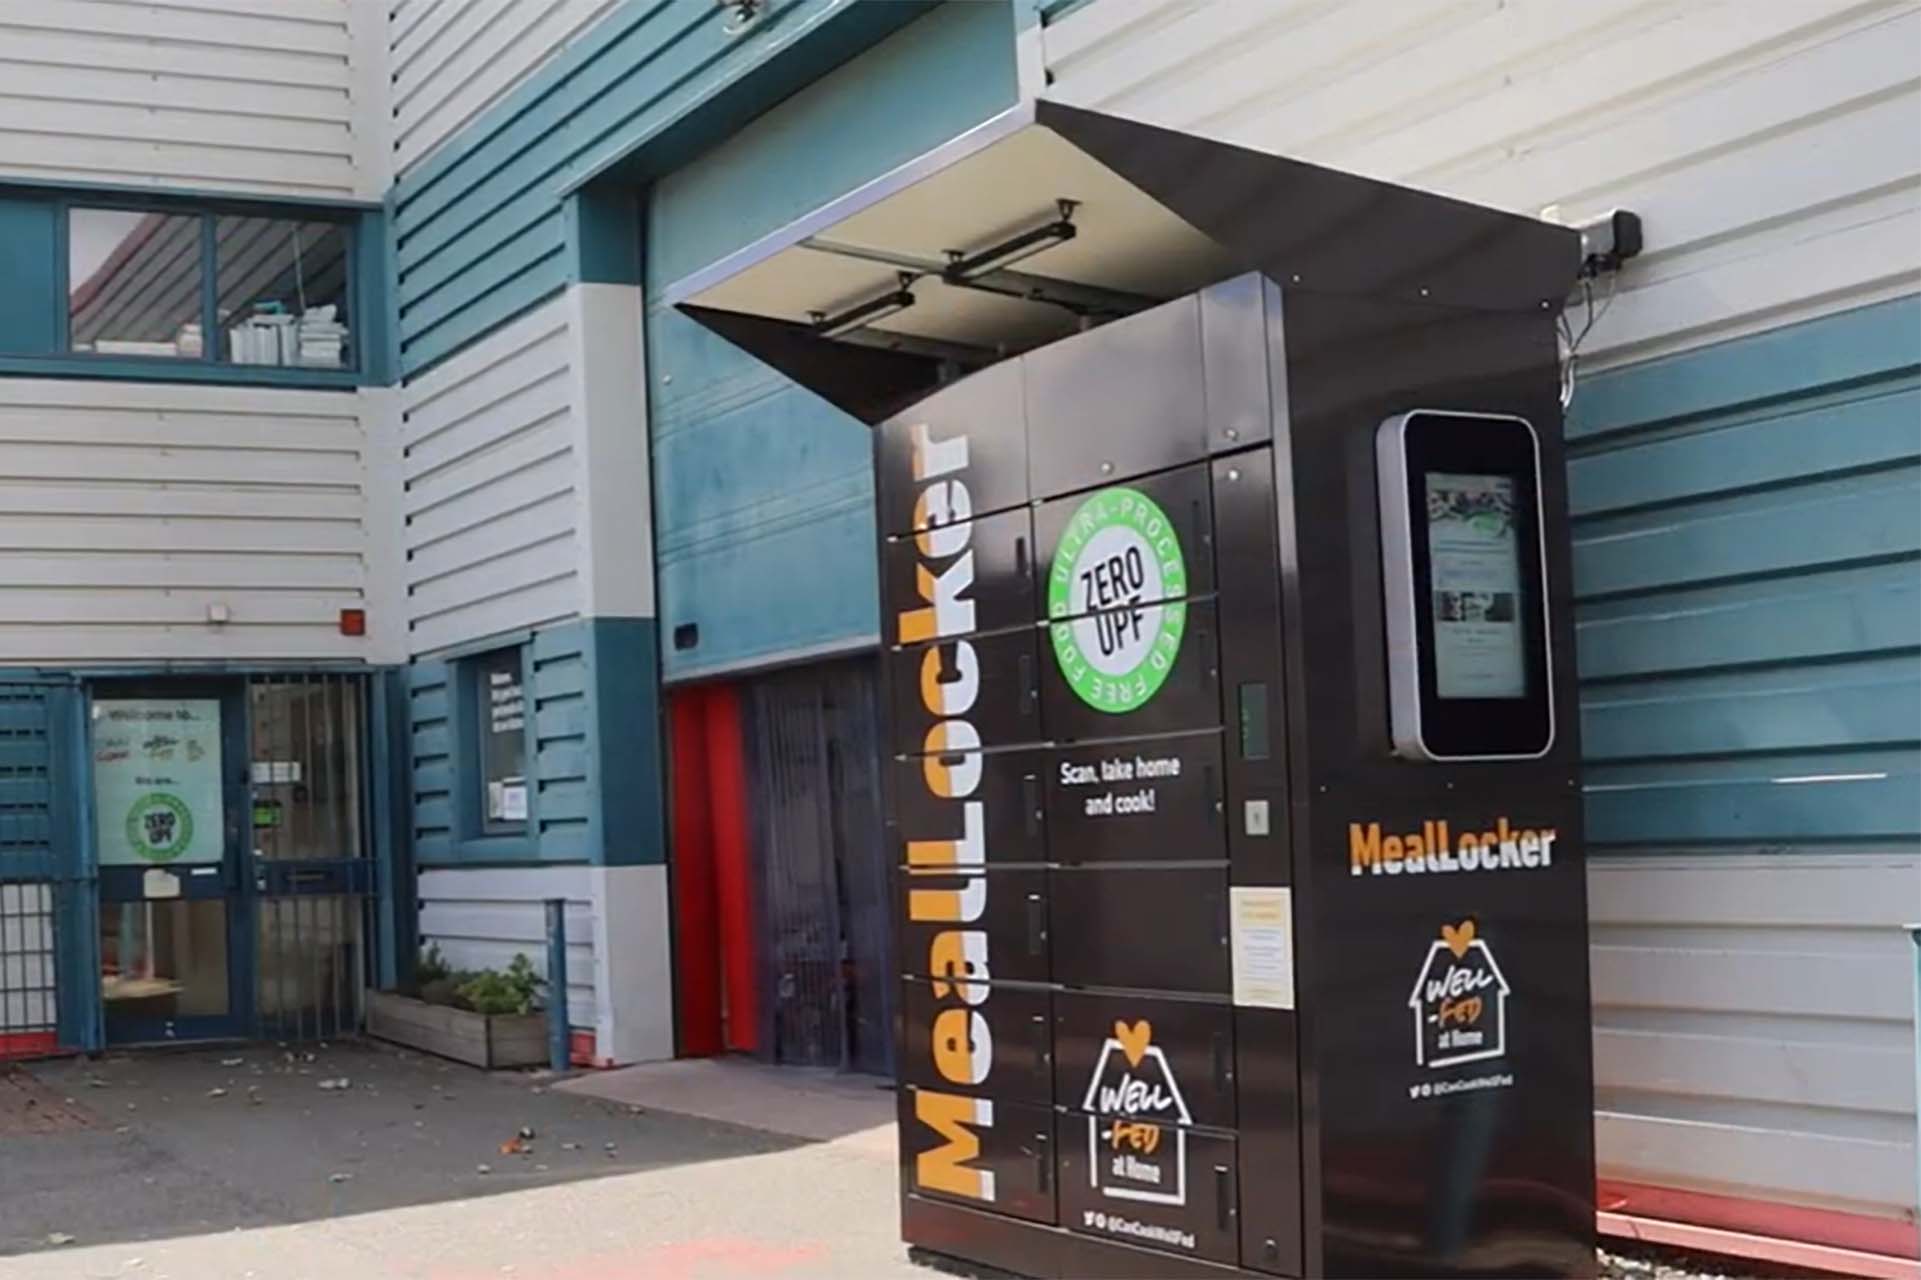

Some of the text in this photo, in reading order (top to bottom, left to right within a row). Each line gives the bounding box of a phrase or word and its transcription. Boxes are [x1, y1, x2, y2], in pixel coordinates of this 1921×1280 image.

[1081, 546, 1145, 613] ZERO
[1055, 601, 1087, 684] FOOD
[1096, 595, 1145, 657] UPF
[1091, 672, 1148, 705] FREE
[1061, 756, 1180, 784] Scan, take home
[899, 423, 996, 1201] MealLocker
[1085, 789, 1155, 815] and cook!
[1350, 818, 1556, 876] MealLocker
[1426, 964, 1494, 1002] WELL
[1101, 1072, 1172, 1114] WELL
